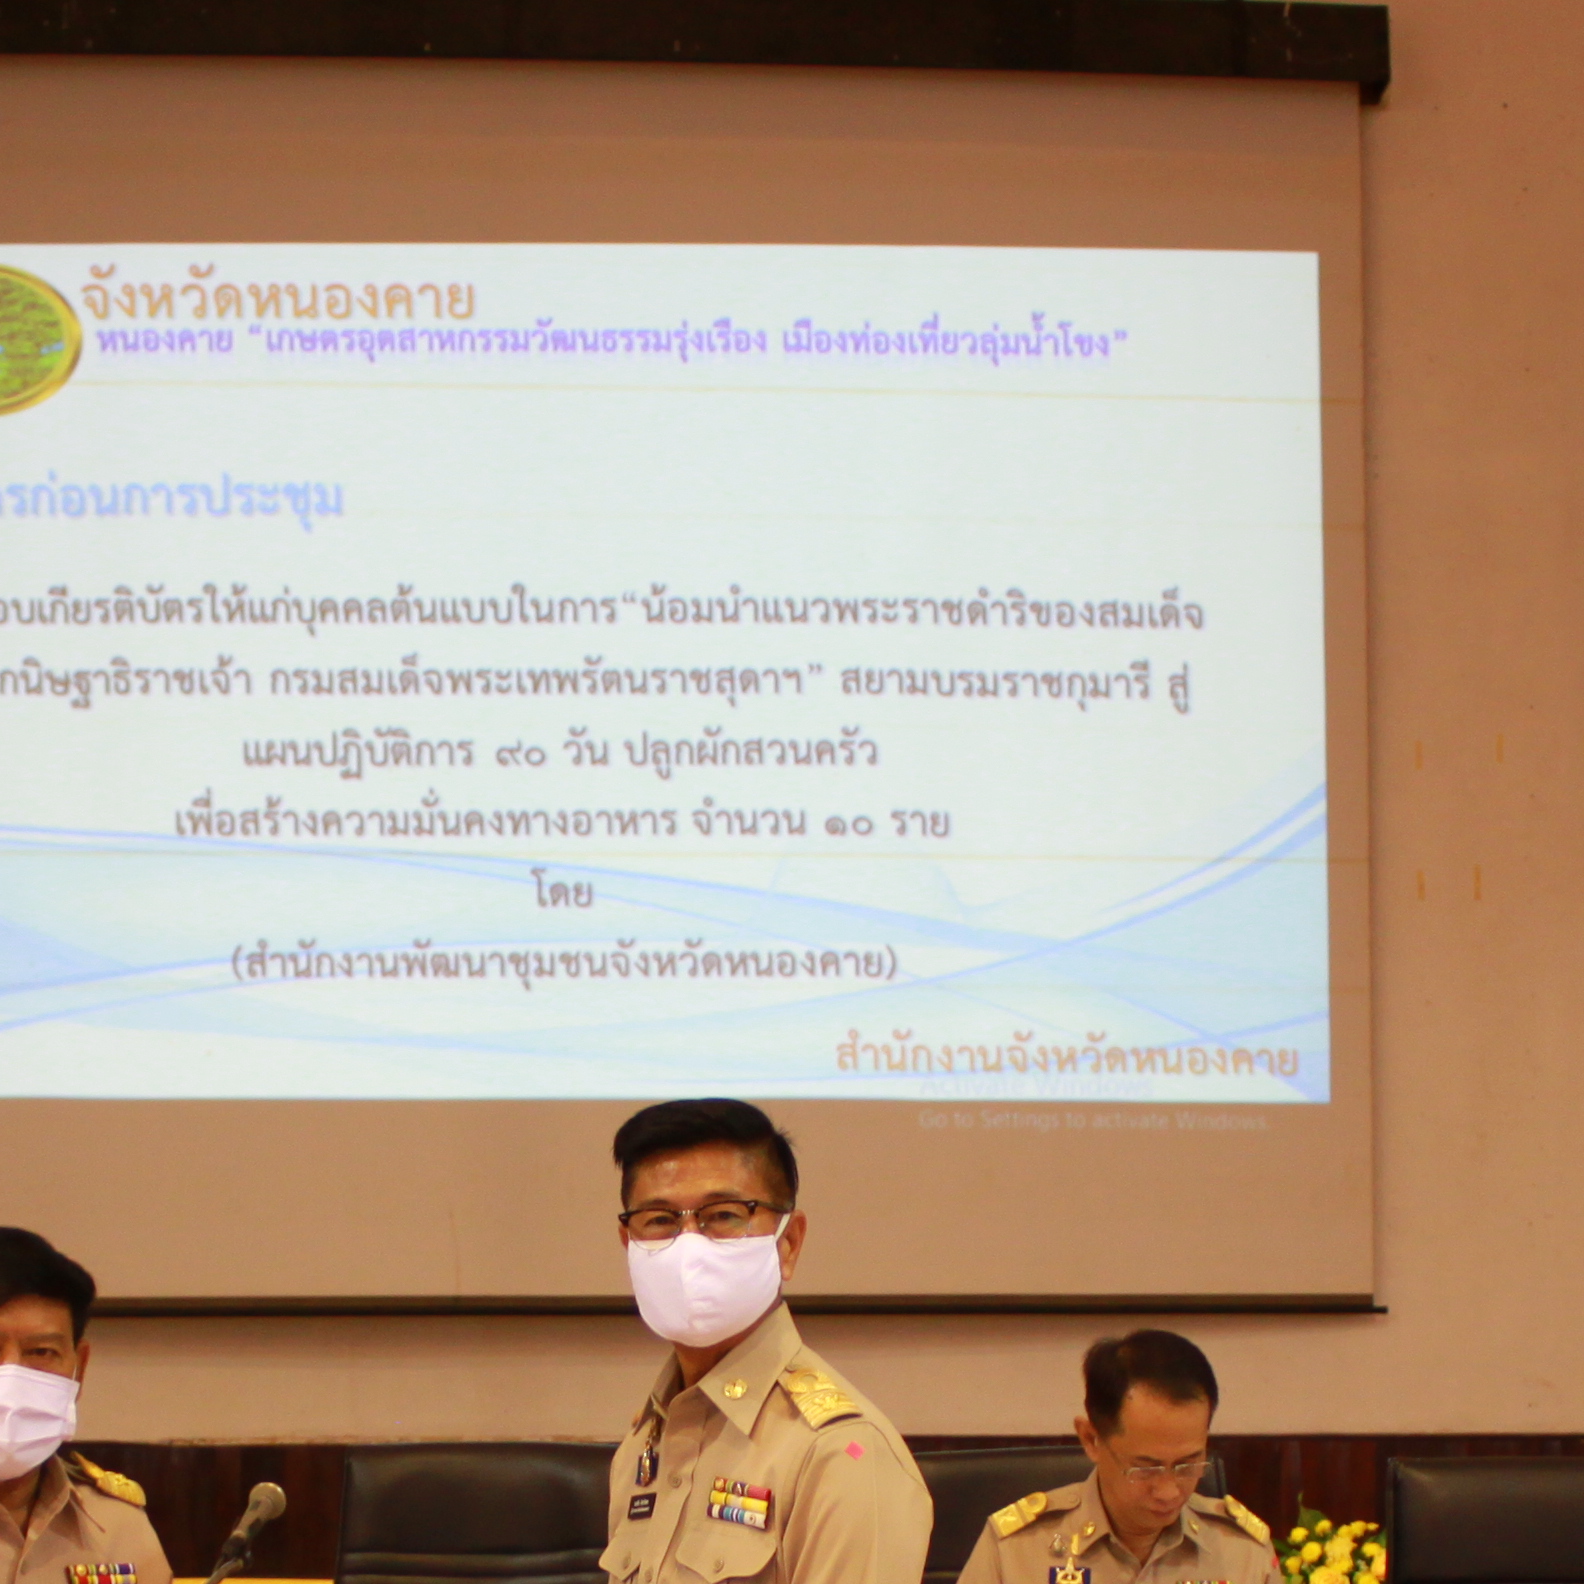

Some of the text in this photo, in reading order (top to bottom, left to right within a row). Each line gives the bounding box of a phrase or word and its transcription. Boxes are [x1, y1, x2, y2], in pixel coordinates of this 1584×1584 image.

[81, 263, 476, 320] จังหวัดหนองคาย
[96, 327, 233, 353] หนองคาย
[841, 658, 1151, 712] สยามบรมราชกุมารี
[1168, 662, 1191, 714] สู่
[243, 725, 879, 781] แผนปฏิบัติการ ๙๐ วัน ปลูกผักสวนครัว
[175, 787, 950, 838] เพื่อสร้างความมั่นคงทางอาหาร จำนวน ๑๐ ราย
[530, 867, 594, 909] โดย
[231, 938, 899, 992] (สำนักงานพัฒนาชุมชนจังหวัดหนองคาย)
[835, 1028, 1301, 1077] สำนักงานจังหวัดหนองคาย
[1034, 1073, 1155, 1098] Windows
[918, 1109, 947, 1130] Go
[954, 1111, 974, 1130] to
[980, 1109, 1060, 1134] Settings
[1065, 1111, 1087, 1131] to
[1092, 1110, 1169, 1131] activate
